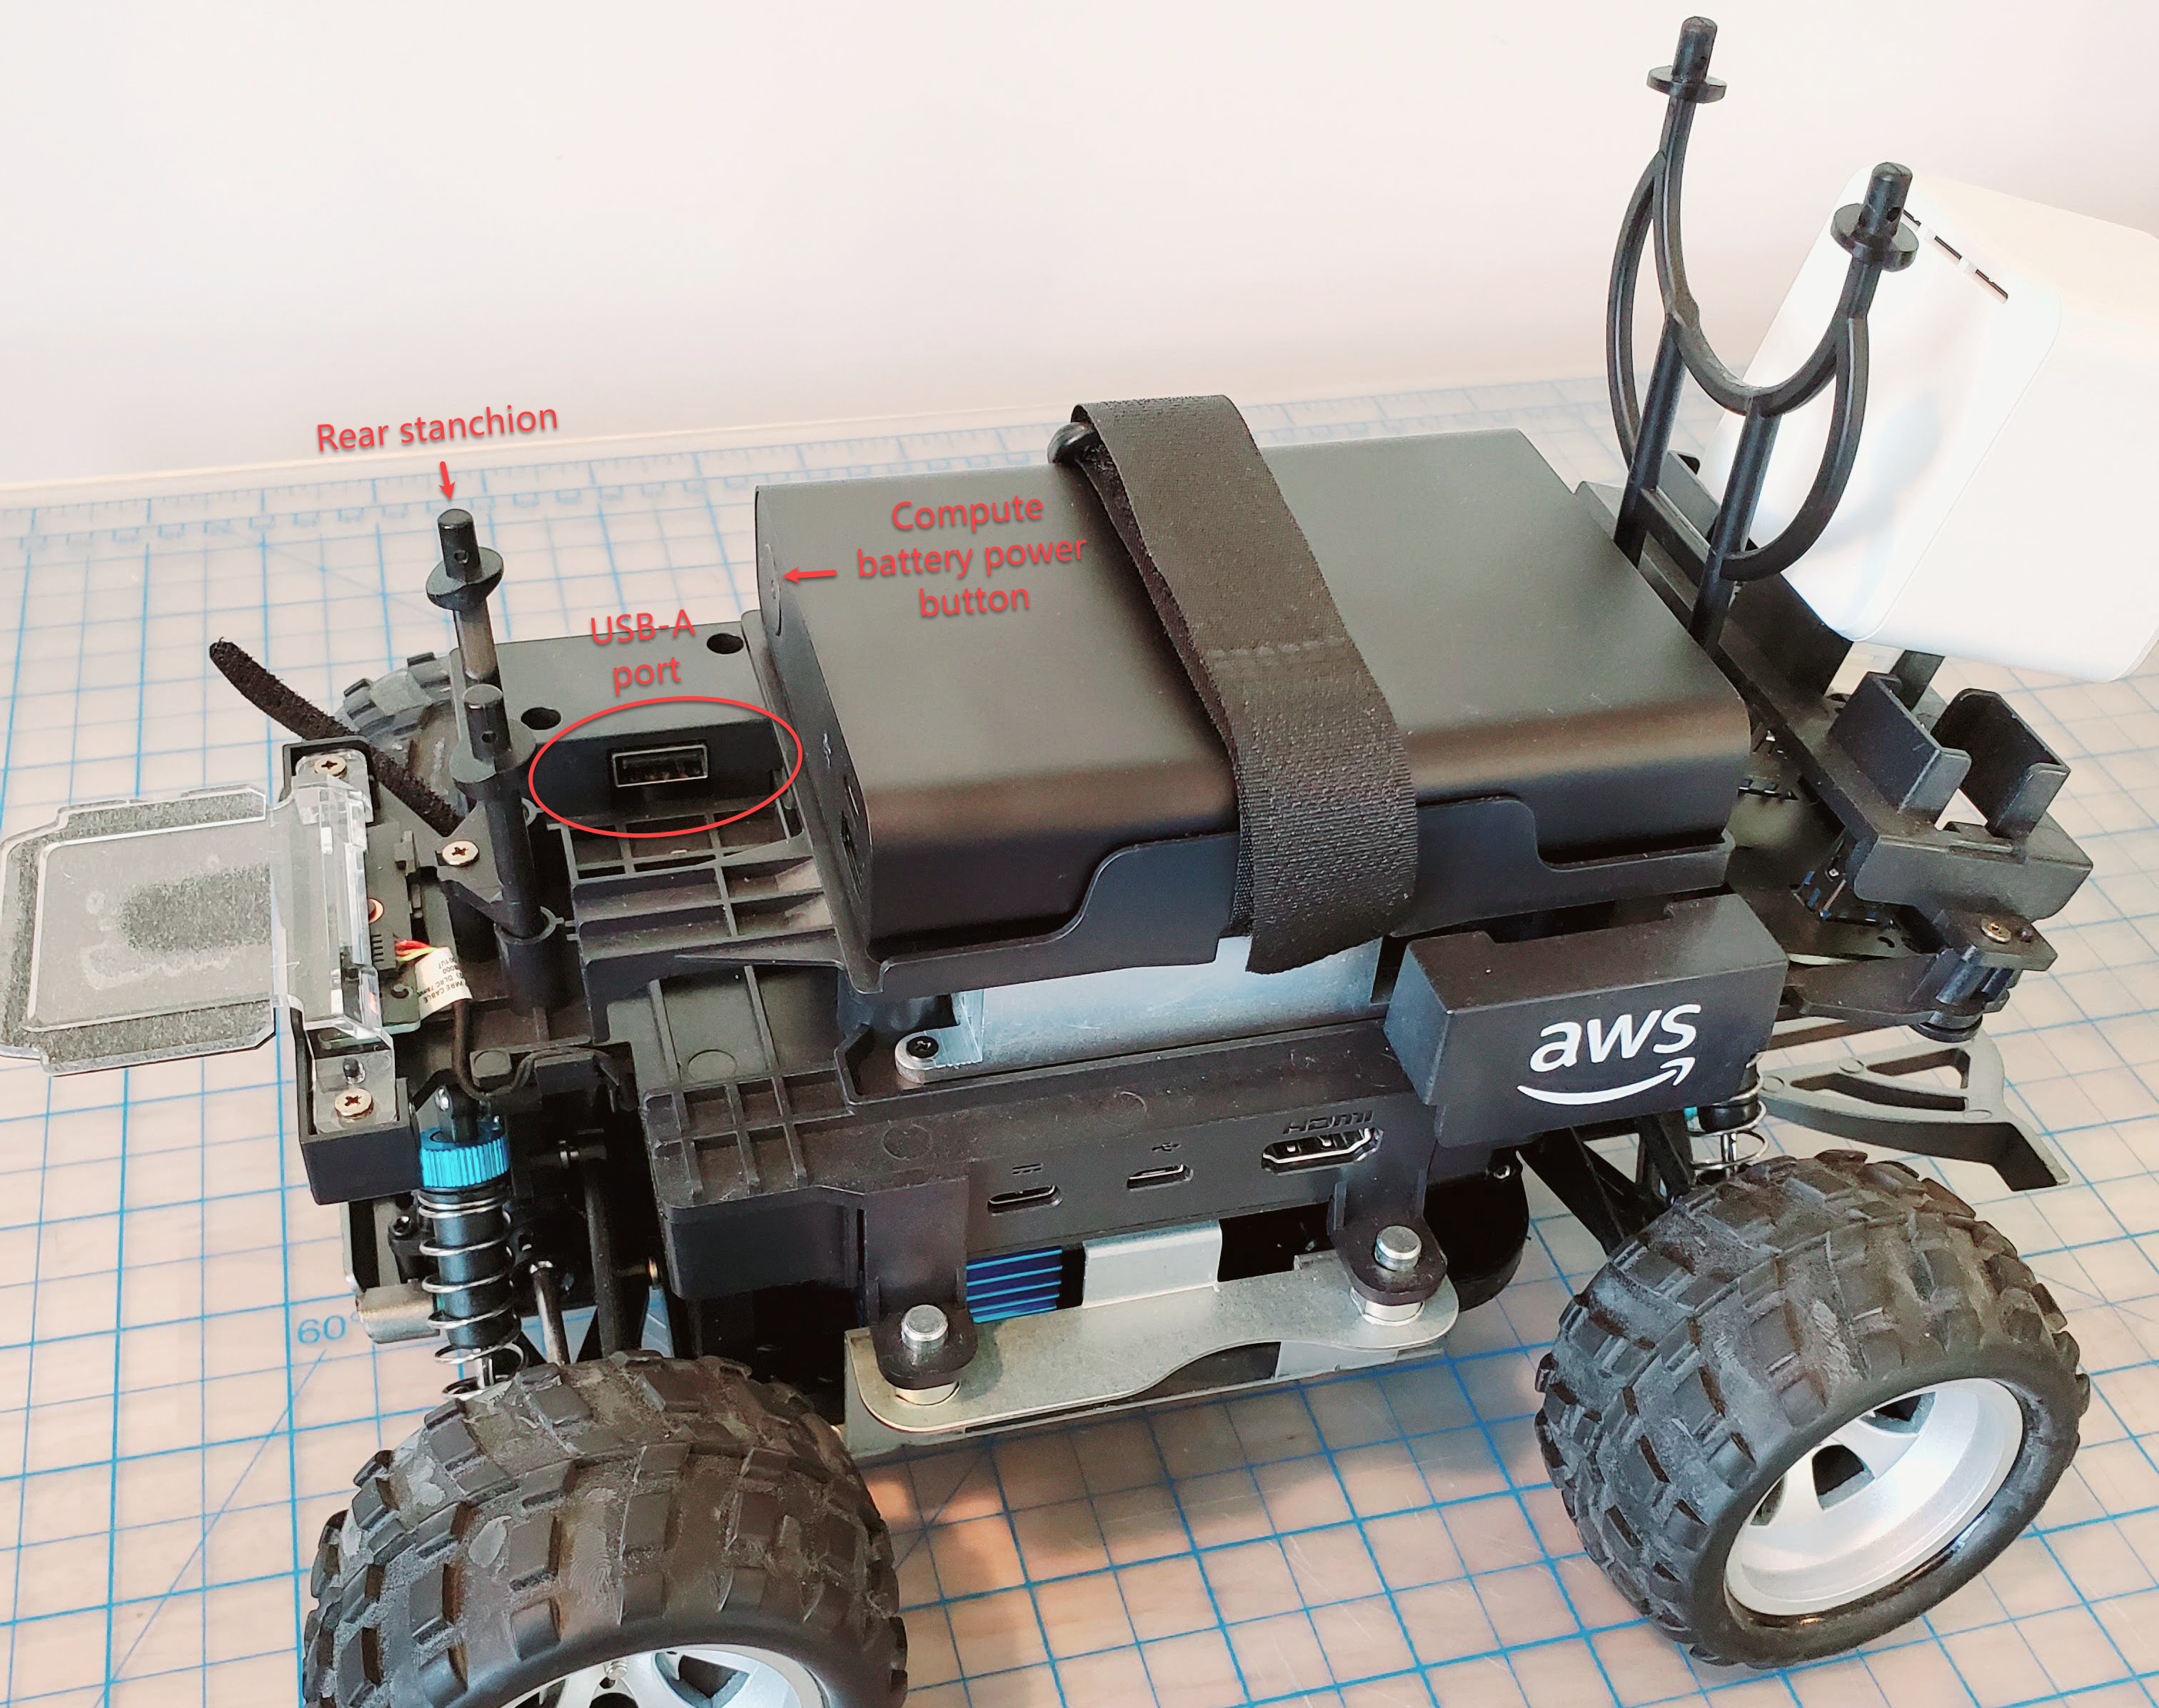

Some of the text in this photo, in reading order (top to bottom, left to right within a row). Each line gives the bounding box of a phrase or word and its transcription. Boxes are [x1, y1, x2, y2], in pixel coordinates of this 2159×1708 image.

[423, 988, 445, 1004] CABLE
[1529, 1003, 1701, 1072] aws
[1283, 1110, 1374, 1135] HDMI
